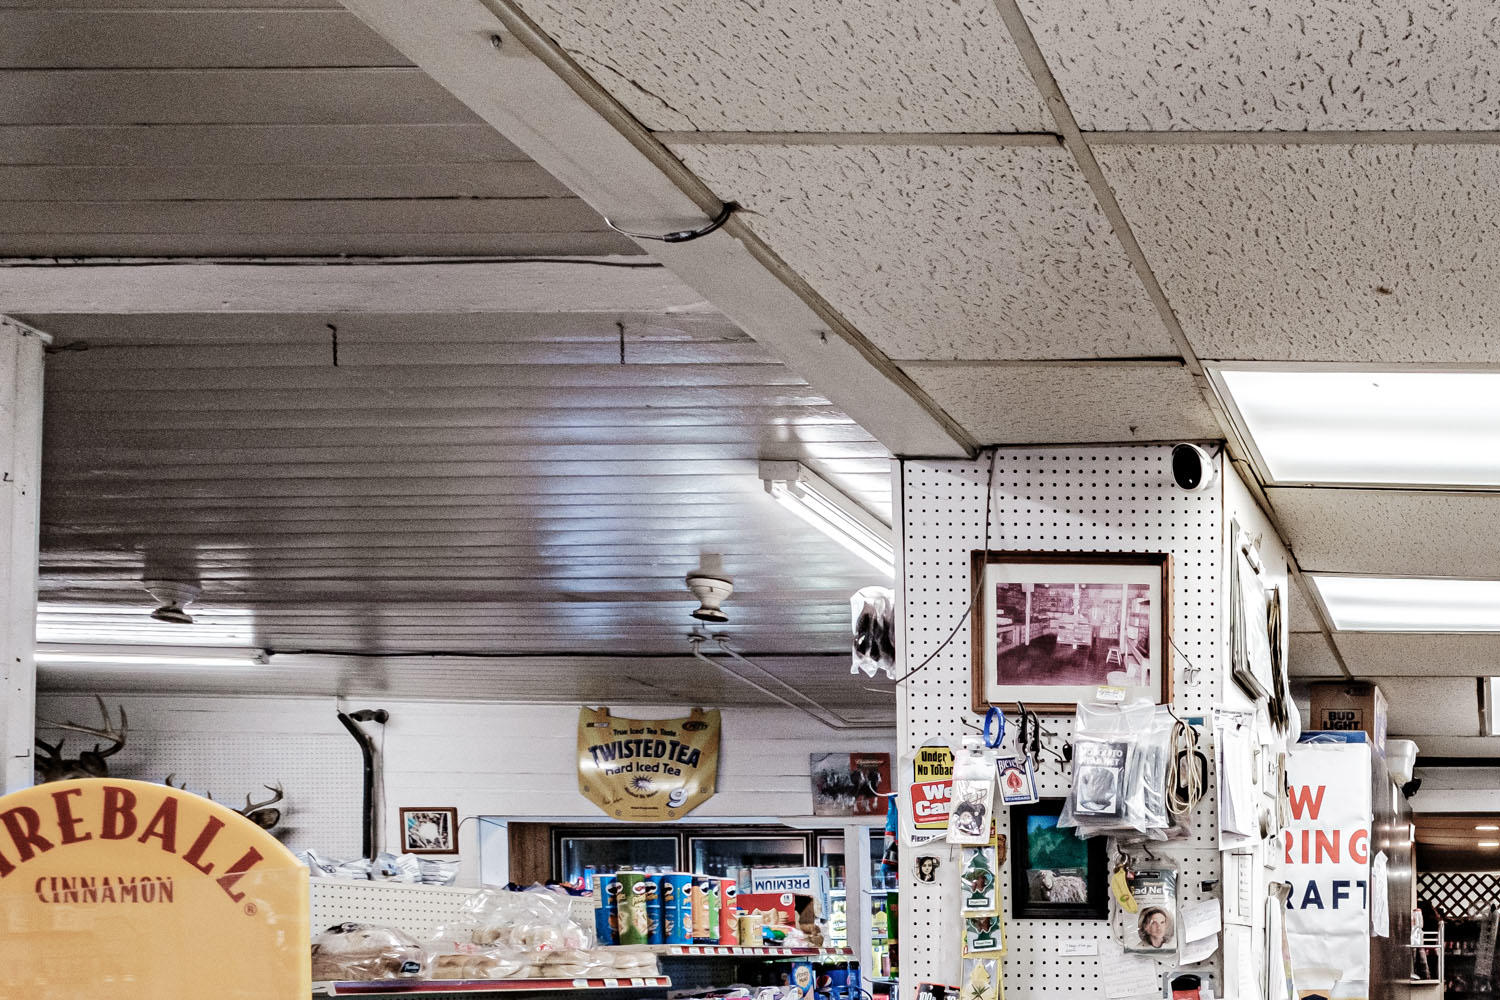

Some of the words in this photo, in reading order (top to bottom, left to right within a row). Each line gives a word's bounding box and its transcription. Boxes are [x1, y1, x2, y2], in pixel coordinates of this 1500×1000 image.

[1329, 712, 1355, 720] BUD
[1324, 721, 1360, 731] LIGHT
[588, 738, 666, 768] TWISTED
[668, 740, 701, 768] TEA
[921, 751, 947, 763] Under
[636, 763, 659, 773] Iced
[663, 763, 681, 777] Tea
[918, 765, 928, 775] No
[666, 787, 688, 809] 9
[922, 784, 952, 800] We
[35, 876, 174, 904] CINNAMON
[755, 879, 810, 889] PREMIUM
